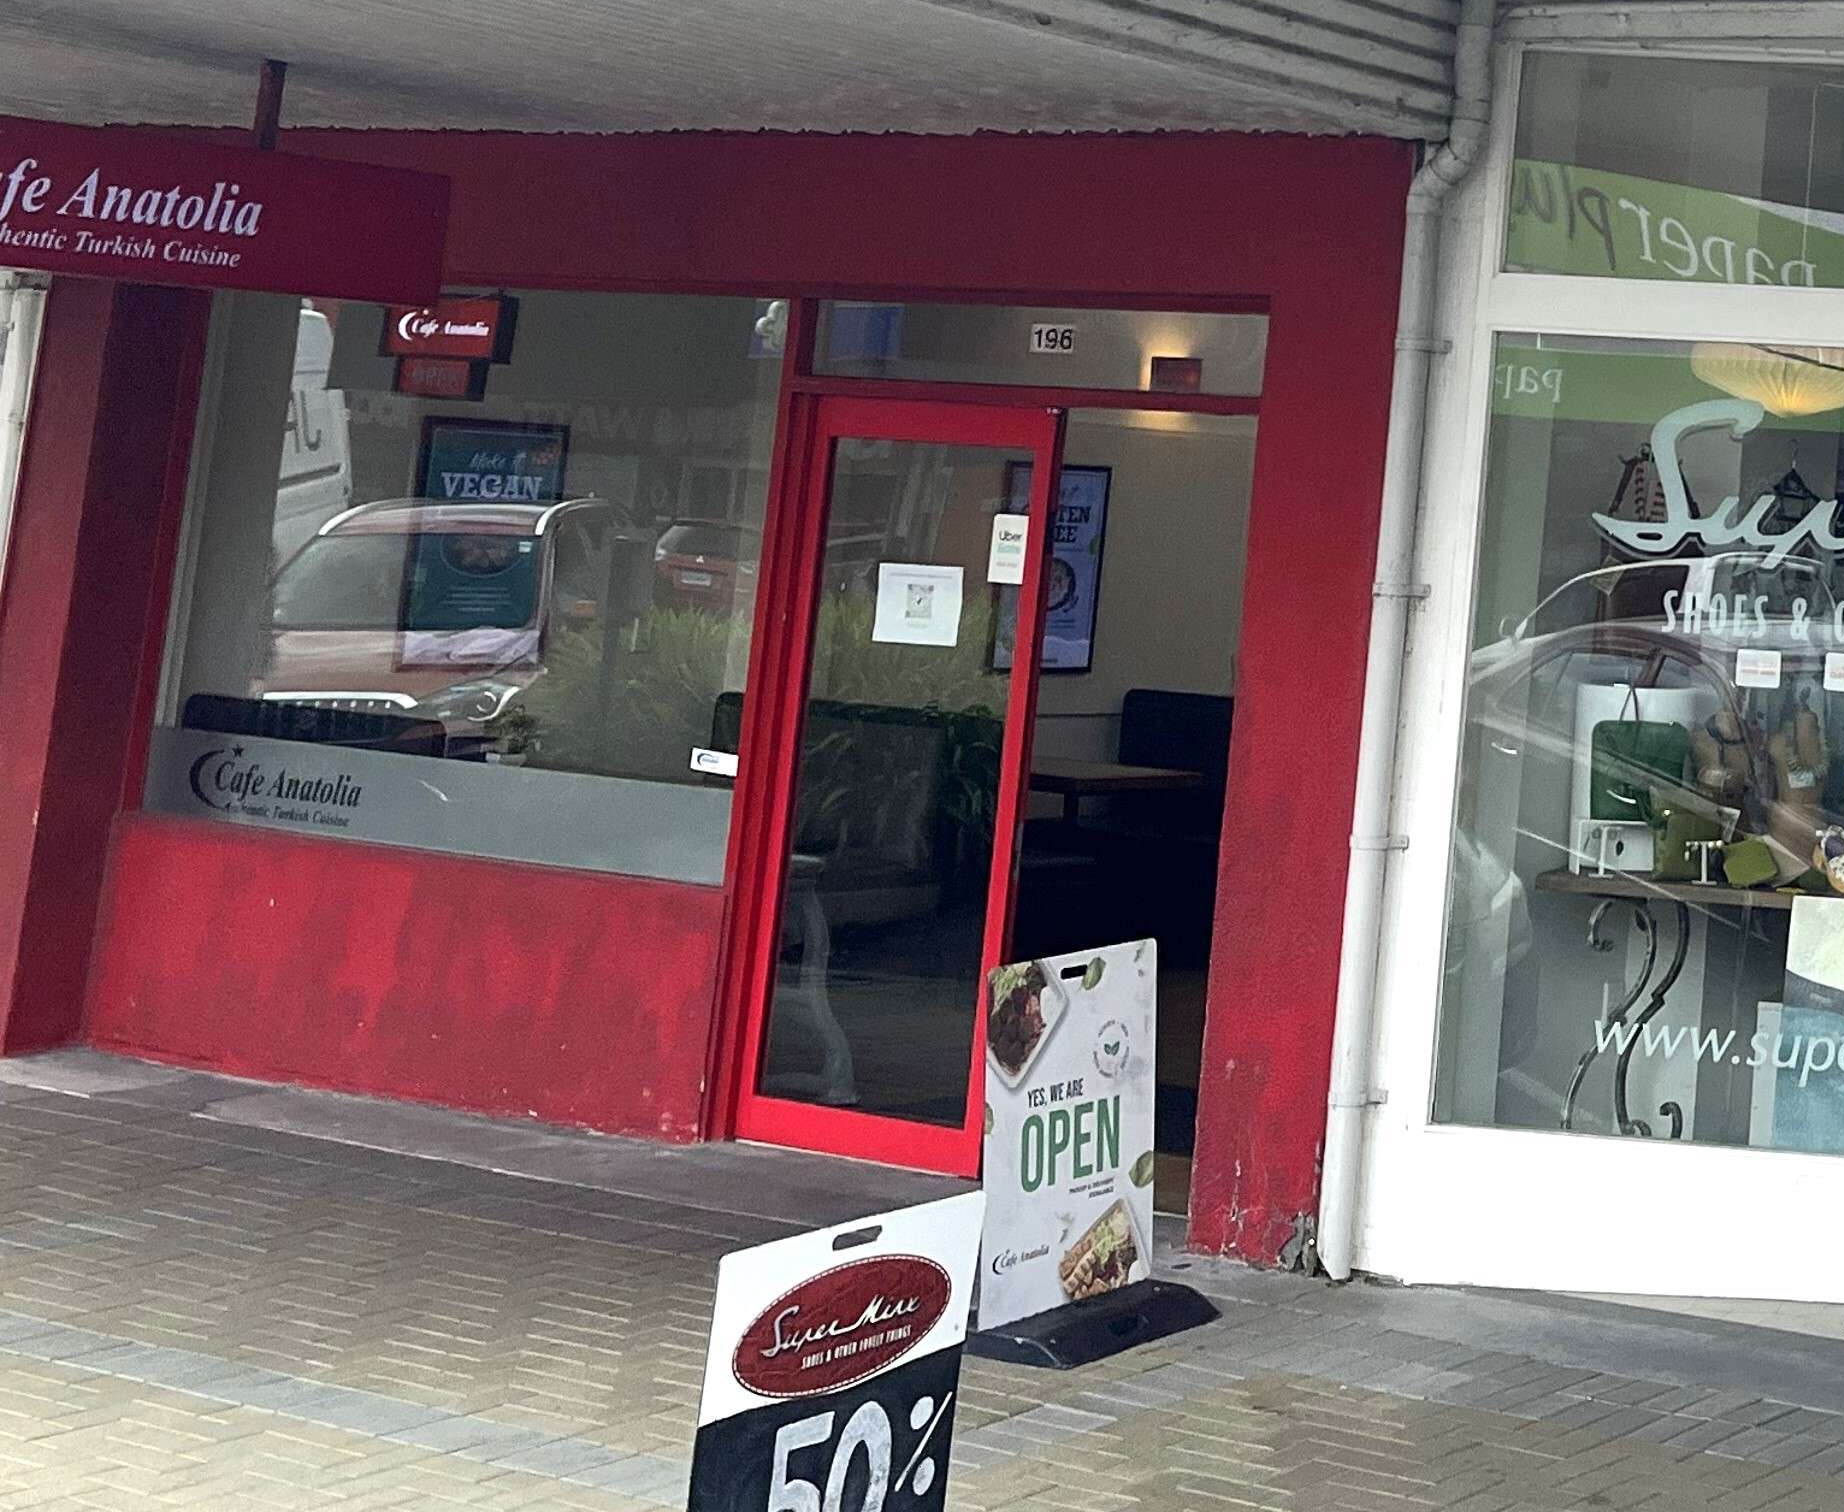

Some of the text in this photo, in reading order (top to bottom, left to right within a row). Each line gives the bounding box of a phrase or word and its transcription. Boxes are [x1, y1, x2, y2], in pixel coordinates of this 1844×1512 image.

[0, 158, 263, 238] fe Anatolia
[74, 230, 155, 260] Turkish
[163, 239, 242, 269] Cuisine
[1033, 328, 1073, 351] 196
[440, 471, 543, 501] VEGAN
[998, 529, 1023, 542] Uber
[1660, 589, 1770, 639] SHOES
[1789, 597, 1811, 640] &
[215, 760, 362, 808] Cafe Anatolia
[1027, 1078, 1084, 1109] YES, WE ARE
[1021, 1094, 1120, 1193] OPEN
[767, 1390, 953, 1512] 50%
